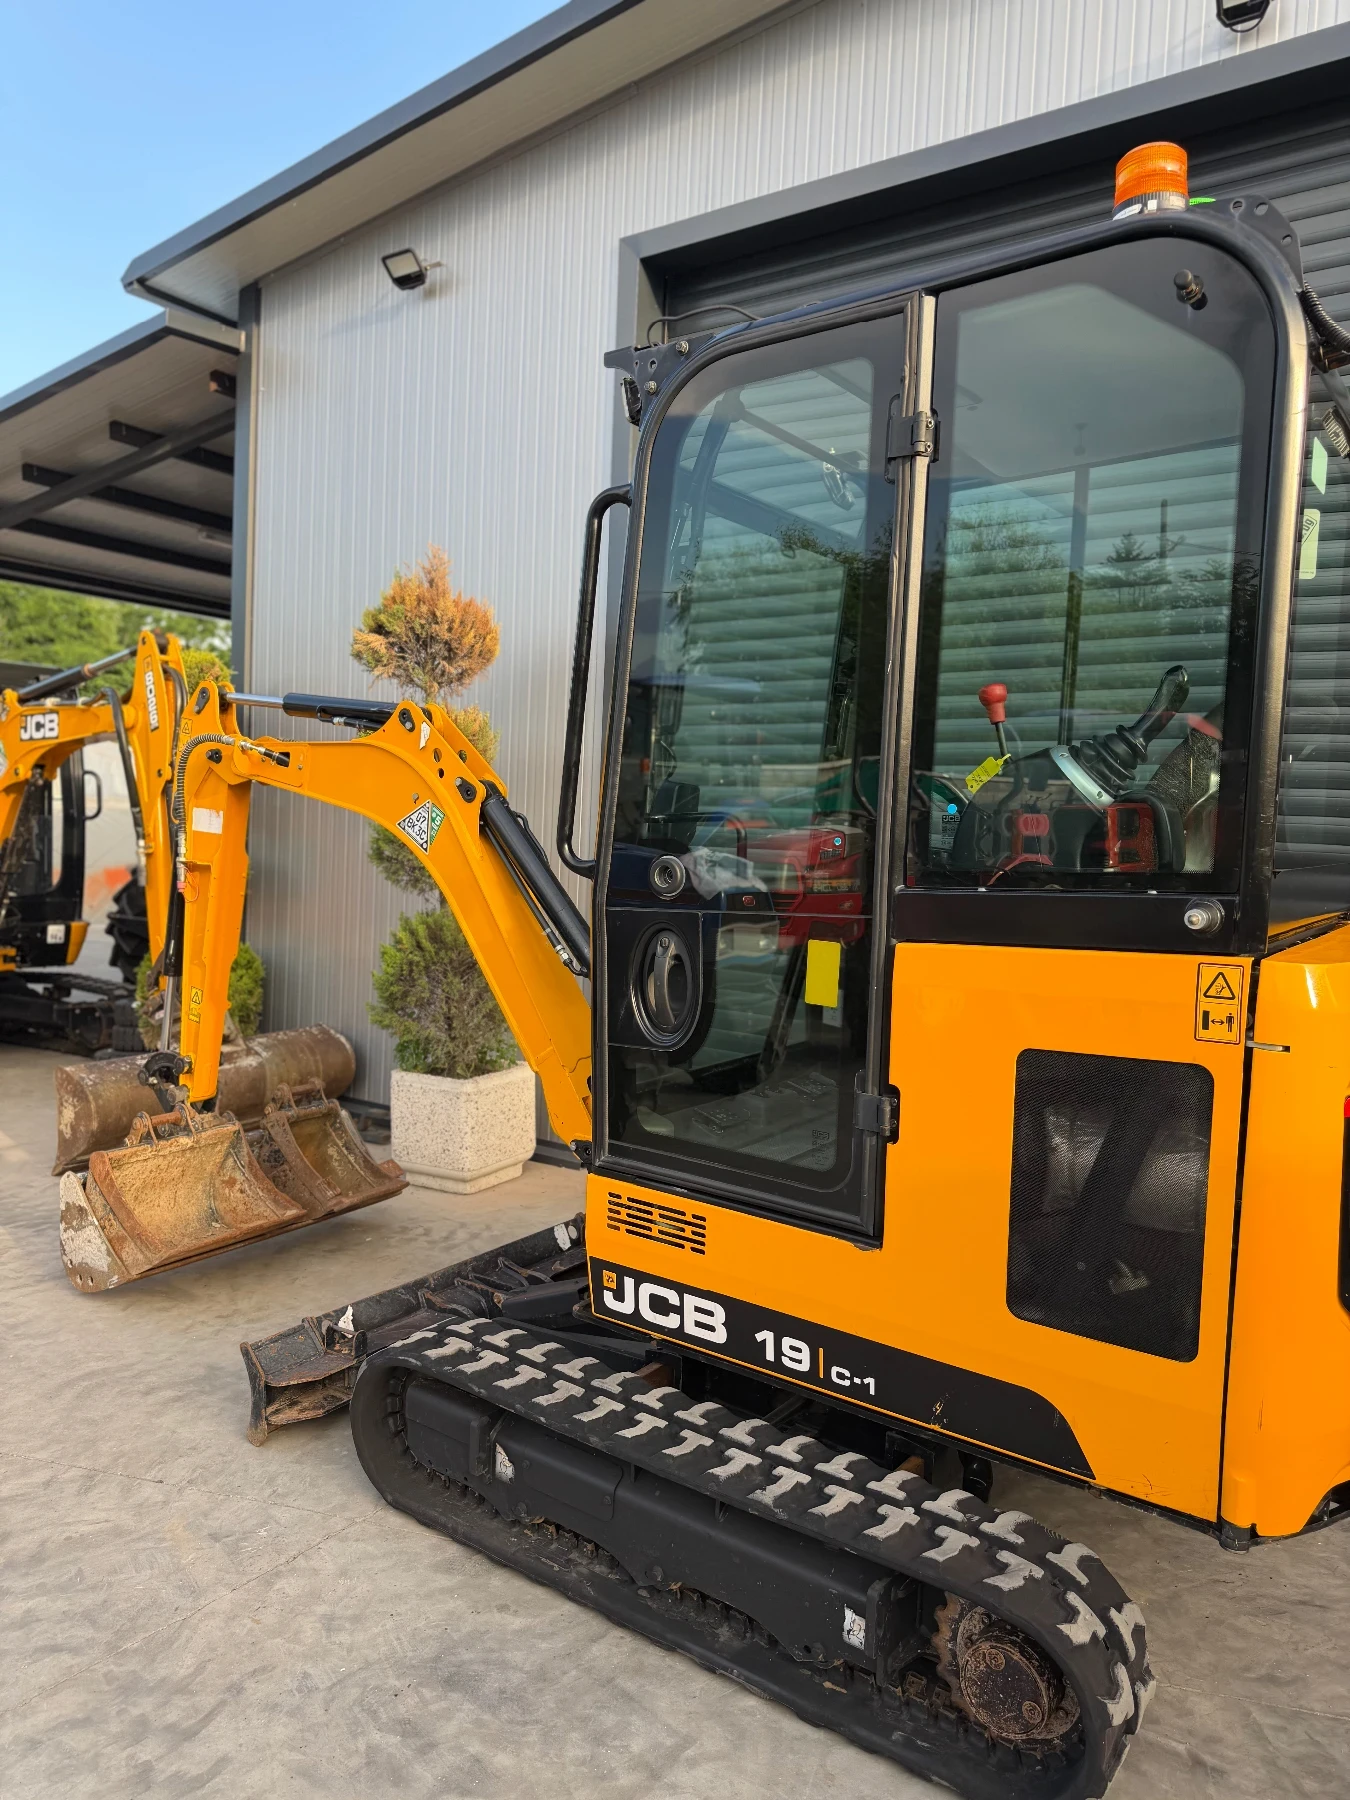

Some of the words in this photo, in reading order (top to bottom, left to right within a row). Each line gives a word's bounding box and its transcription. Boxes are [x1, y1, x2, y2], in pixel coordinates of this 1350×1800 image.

[20, 713, 59, 741] JCB
[603, 1275, 728, 1345] JCB
[755, 1329, 811, 1373] 19
